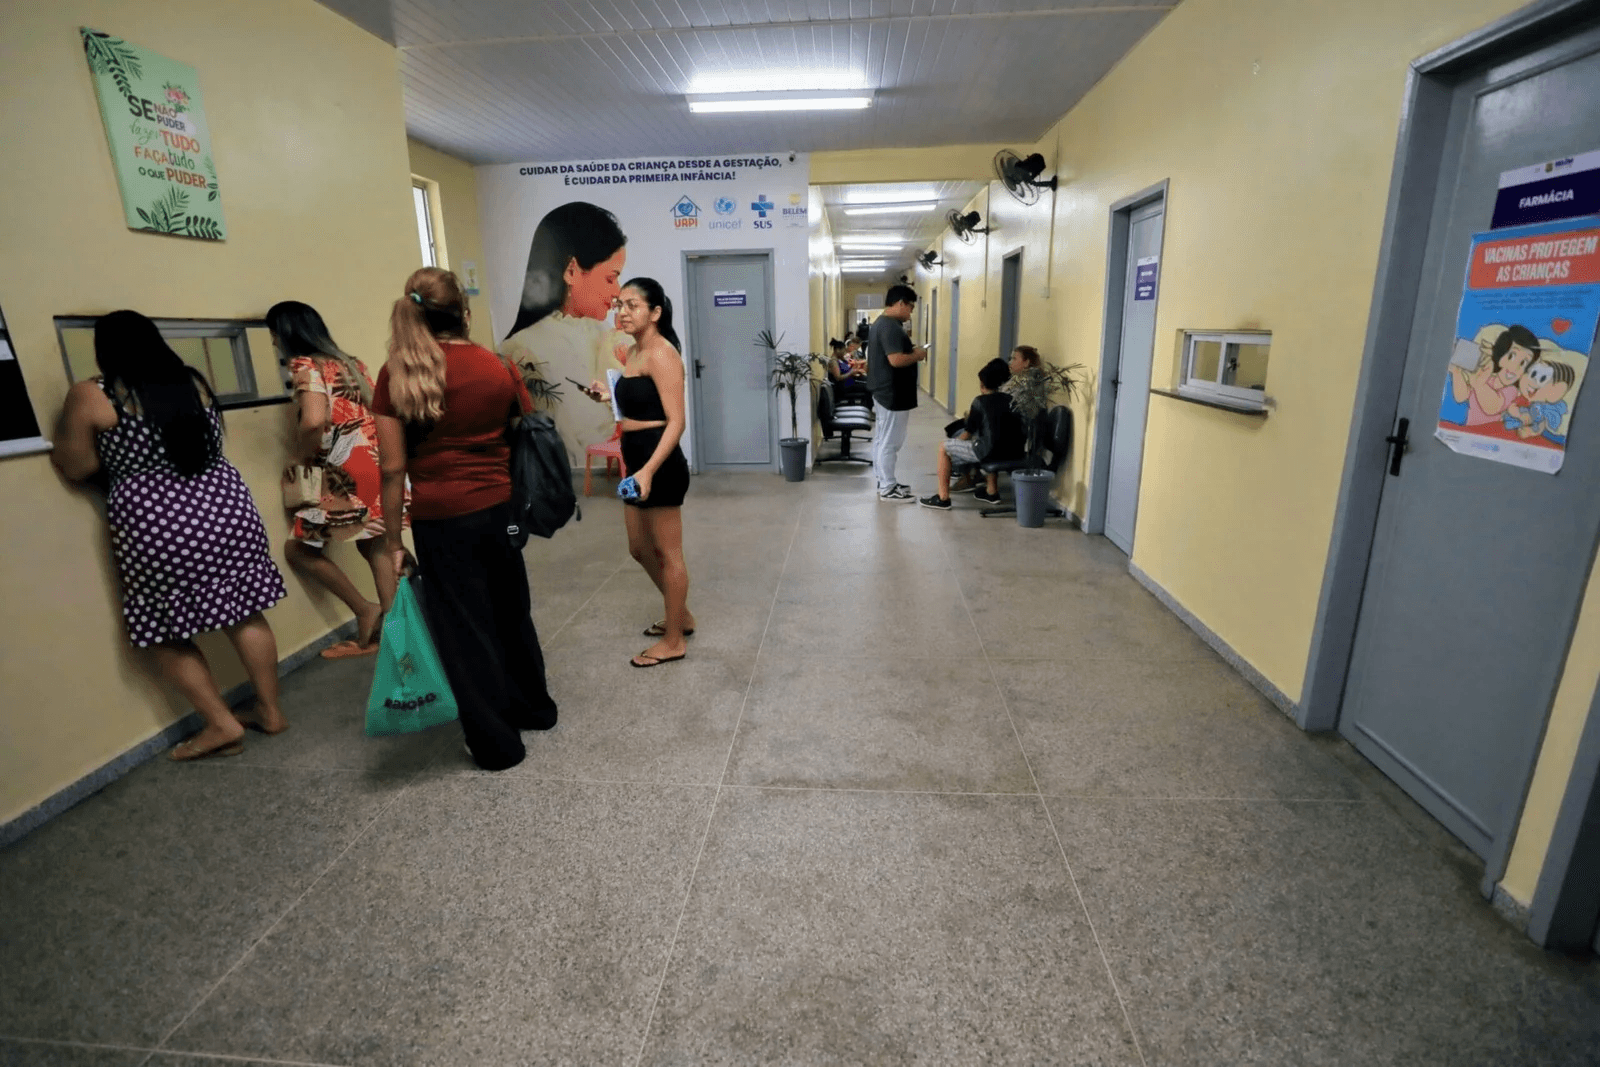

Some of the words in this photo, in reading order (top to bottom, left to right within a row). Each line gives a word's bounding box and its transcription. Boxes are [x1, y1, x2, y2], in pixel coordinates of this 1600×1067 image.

[128, 95, 155, 121] SE
[157, 114, 186, 131] PUDER
[159, 129, 200, 154] TUDO
[134, 146, 168, 165] FAÇA
[167, 148, 195, 170] tudo
[519, 166, 558, 176] CUIDAR
[560, 165, 574, 174] DA
[576, 161, 610, 172] SAÚDE
[612, 163, 626, 171] DA
[628, 161, 676, 172] CRIANÇA
[678, 159, 711, 168] DESDE
[713, 159, 721, 168] A
[723, 156, 782, 169] GESTAÇÃO,
[147, 168, 166, 180] QUE
[165, 167, 207, 188] PUDER
[564, 175, 570, 185] É
[571, 175, 611, 185] CUIDAR
[612, 175, 627, 184] DA
[629, 173, 678, 183] PRIMEIRA
[680, 170, 736, 181] INFÂNCIA!
[1518, 189, 1574, 209] FARMÁCIA
[782, 207, 808, 215] BELÉM
[674, 217, 698, 228] URPI
[709, 219, 742, 230] unicef
[753, 220, 772, 229] SUS
[1484, 244, 1528, 264] VACINAS
[1528, 235, 1599, 260] PROTEGEM
[1496, 264, 1511, 282] AS
[1512, 259, 1570, 284] CRIANÇAS
